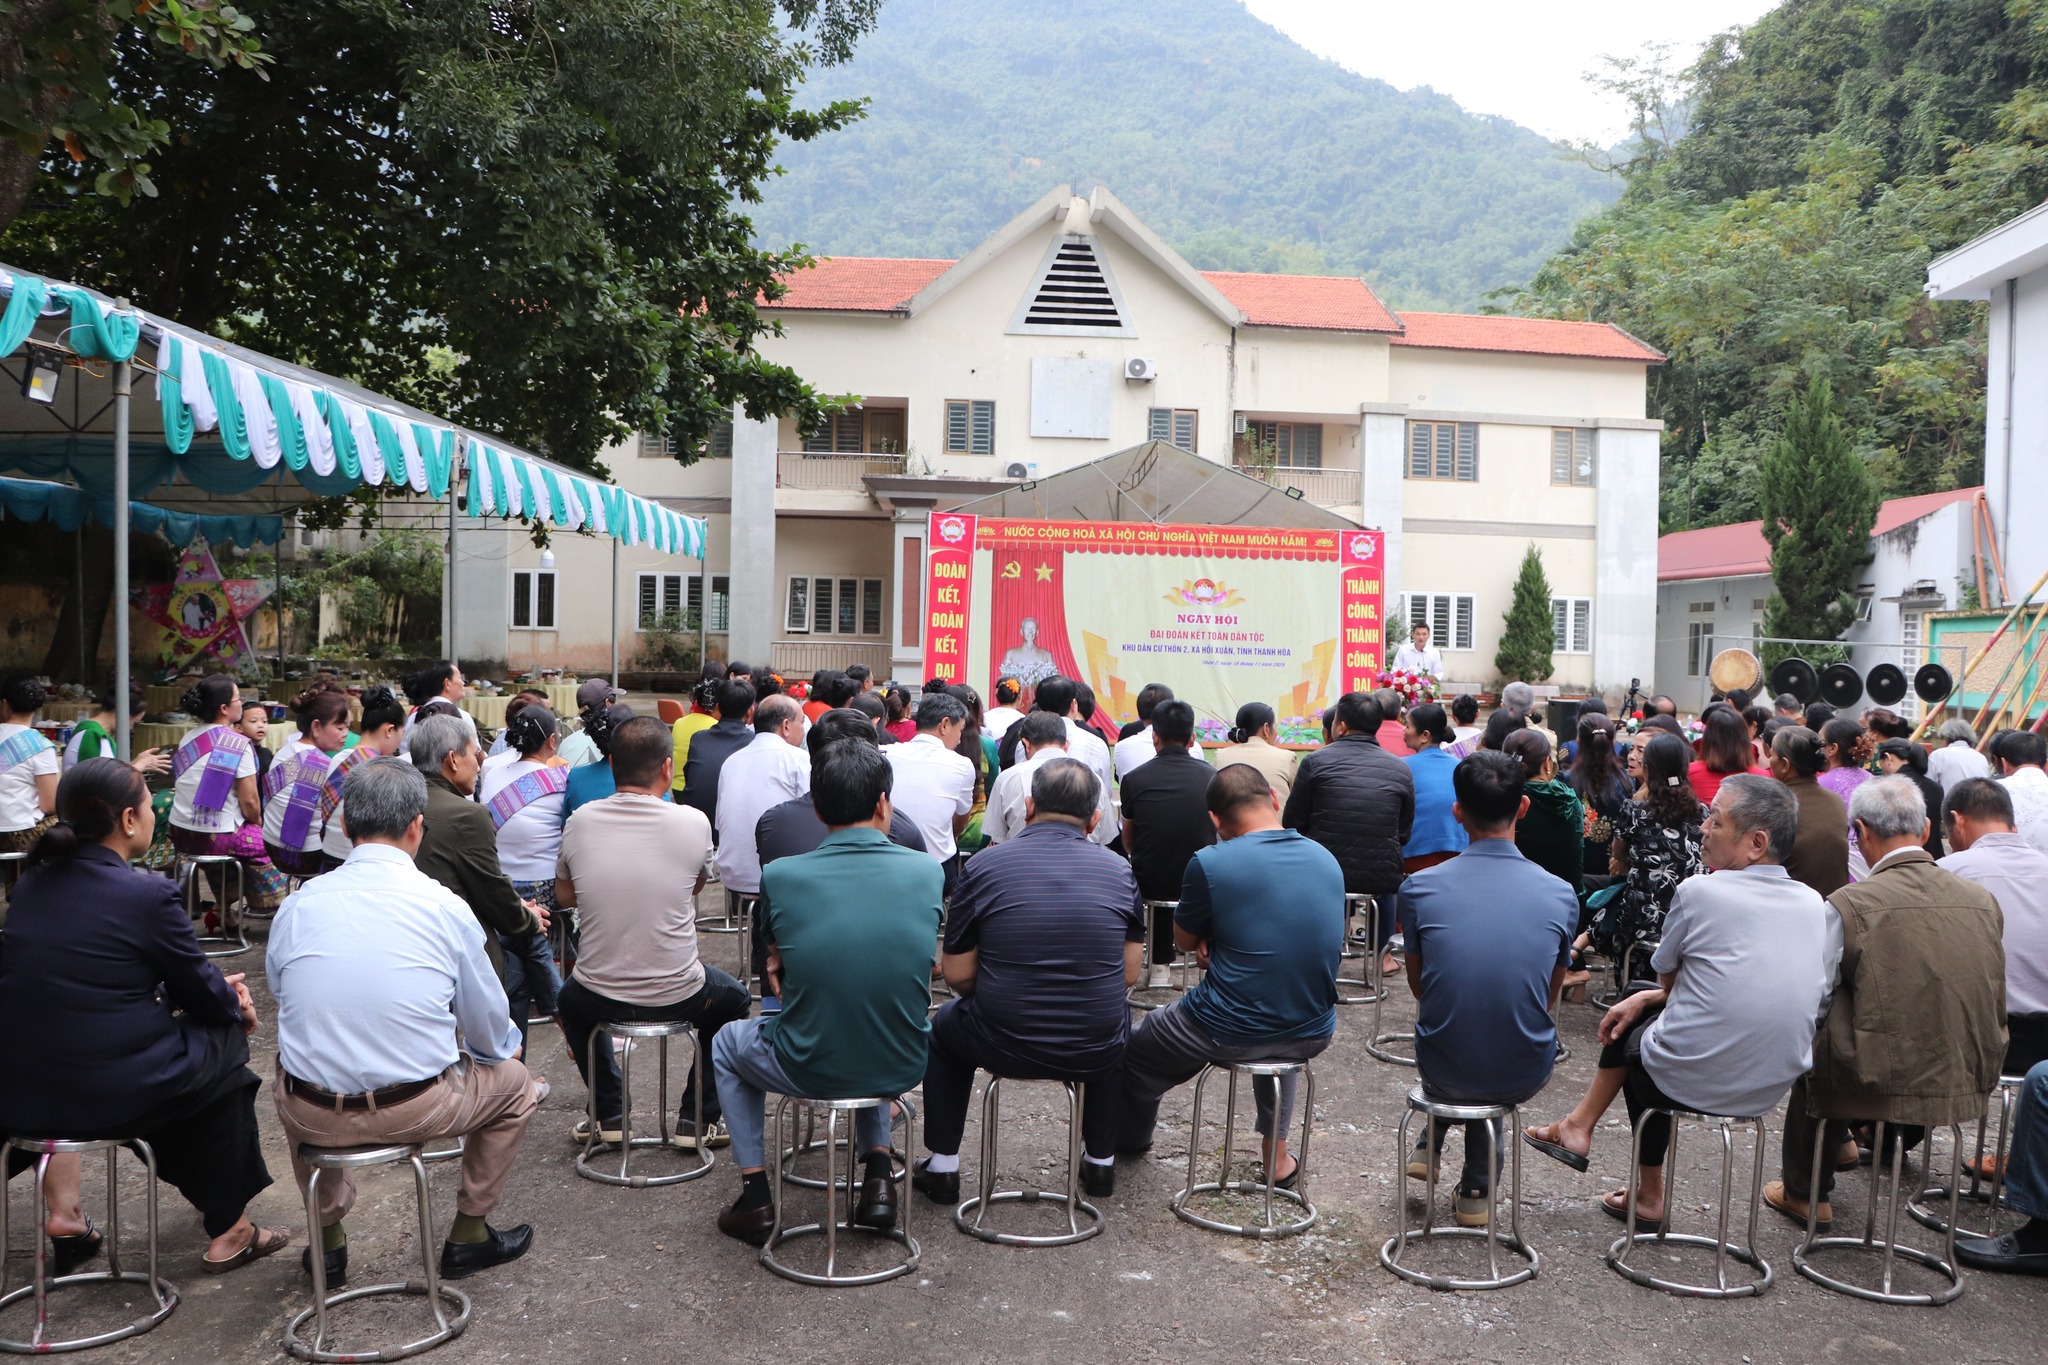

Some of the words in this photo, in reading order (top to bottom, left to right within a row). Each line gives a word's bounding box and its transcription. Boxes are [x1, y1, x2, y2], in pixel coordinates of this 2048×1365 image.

[1004, 524, 1035, 537] NƯỚC
[1038, 526, 1070, 540] CỘNG
[1073, 526, 1096, 539] HOÀ
[1098, 527, 1114, 540] XÃ
[1117, 528, 1135, 543] HỘI
[1138, 528, 1160, 541] CHỦ
[1163, 530, 1196, 543] NGHĨA
[1198, 531, 1219, 546] VIỆT
[1221, 533, 1245, 544] NAM
[1247, 532, 1278, 546] MUÔN
[1281, 533, 1307, 546] NĂM!
[934, 560, 967, 579] ĐOÀN
[937, 583, 961, 605] KẾT,
[1346, 576, 1379, 595] THÀNH
[931, 610, 964, 629] ĐOÀN
[1214, 614, 1238, 626] HỘI
[1347, 601, 1378, 621] CÔNG,
[1150, 629, 1164, 641] ĐẠI
[1166, 628, 1189, 640] ĐOÀN
[1190, 628, 1206, 640] KẾT
[1207, 629, 1229, 641] TOÀN
[1249, 631, 1265, 644] TỘC
[1345, 625, 1379, 644] THÀNH
[935, 633, 958, 656] KẾT,
[1122, 643, 1136, 652] KHU
[1153, 644, 1163, 653] CƯ
[1253, 647, 1276, 656] THANH
[1346, 649, 1378, 670] CÔNG,
[935, 662, 955, 682] ĐẠI
